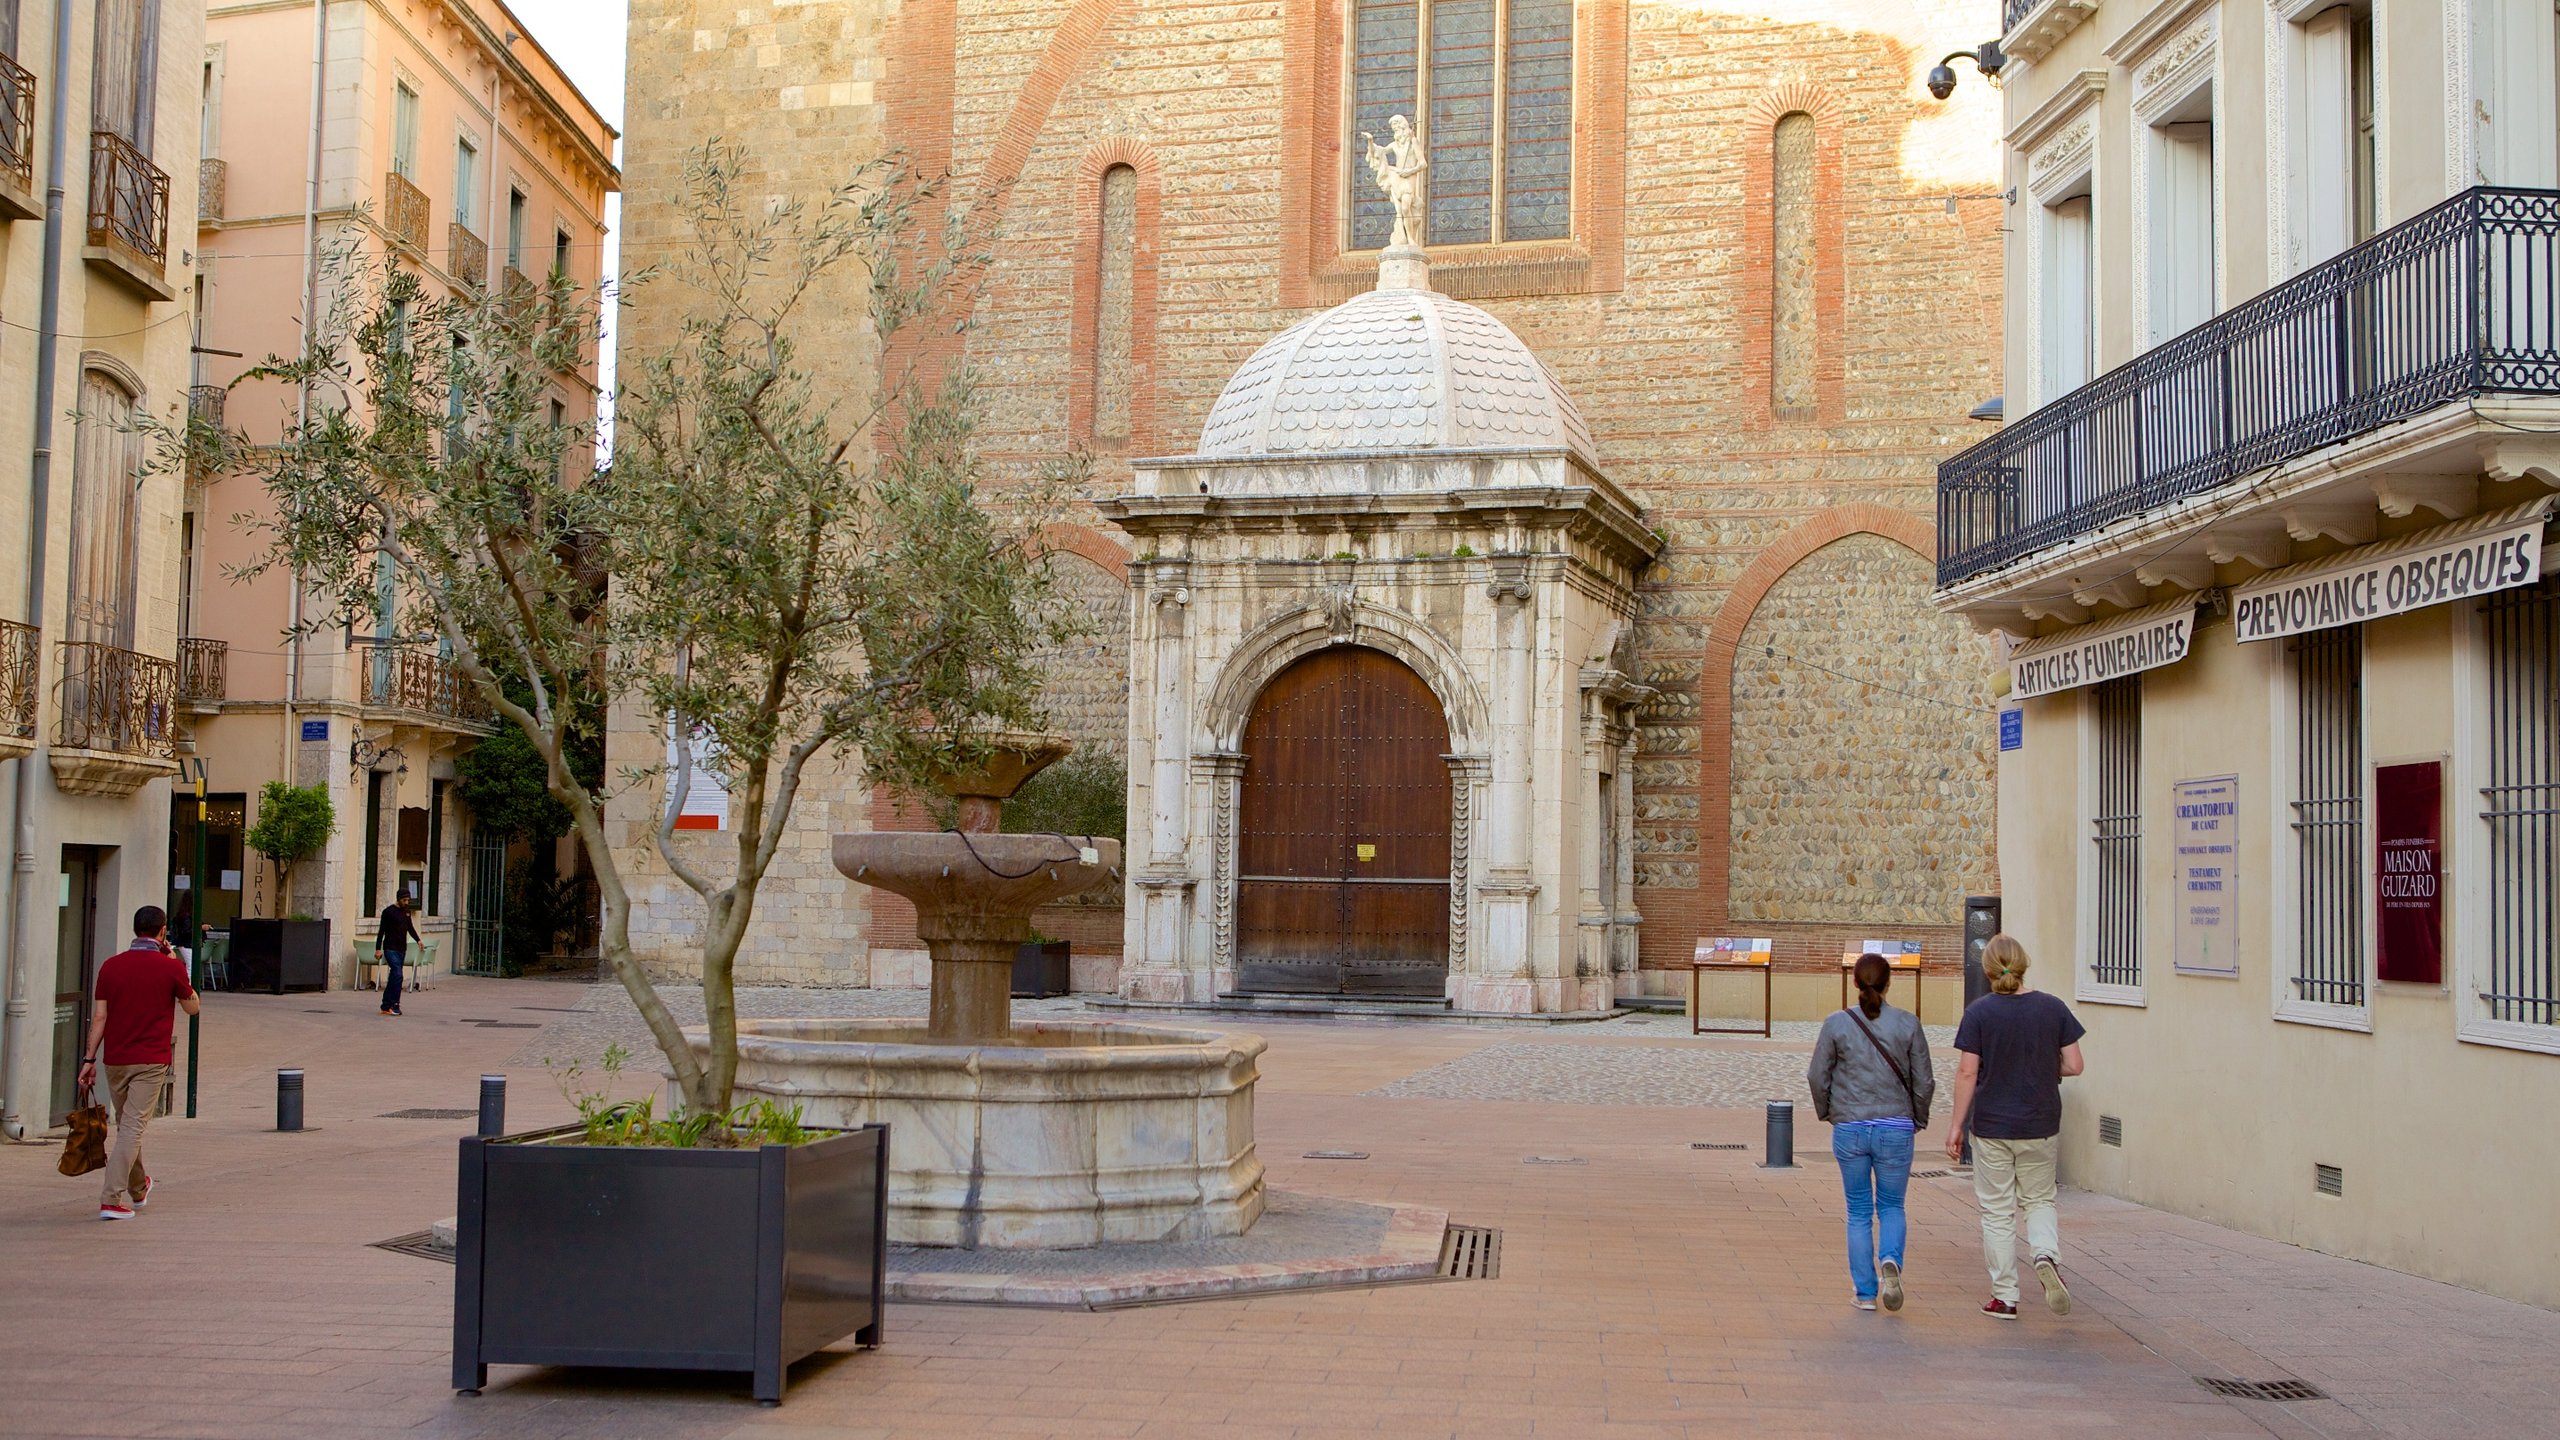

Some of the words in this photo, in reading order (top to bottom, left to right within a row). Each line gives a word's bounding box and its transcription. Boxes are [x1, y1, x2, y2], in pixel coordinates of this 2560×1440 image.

[2237, 571, 2379, 638] PREVOYANCE
[2386, 533, 2532, 610] OBSEQUES
[2018, 649, 2079, 695] ARTICLES
[2084, 620, 2186, 681] FUNERAIRES
[2176, 802, 2234, 818] CREMATORIUM
[2191, 821, 2199, 831] DE
[2200, 820, 2218, 830] CANET
[2384, 849, 2431, 873] MAISON
[2188, 868, 2222, 878] TESTAMENT
[2187, 880, 2223, 891] CREMATISTE
[2381, 874, 2436, 897] GUIZARD
